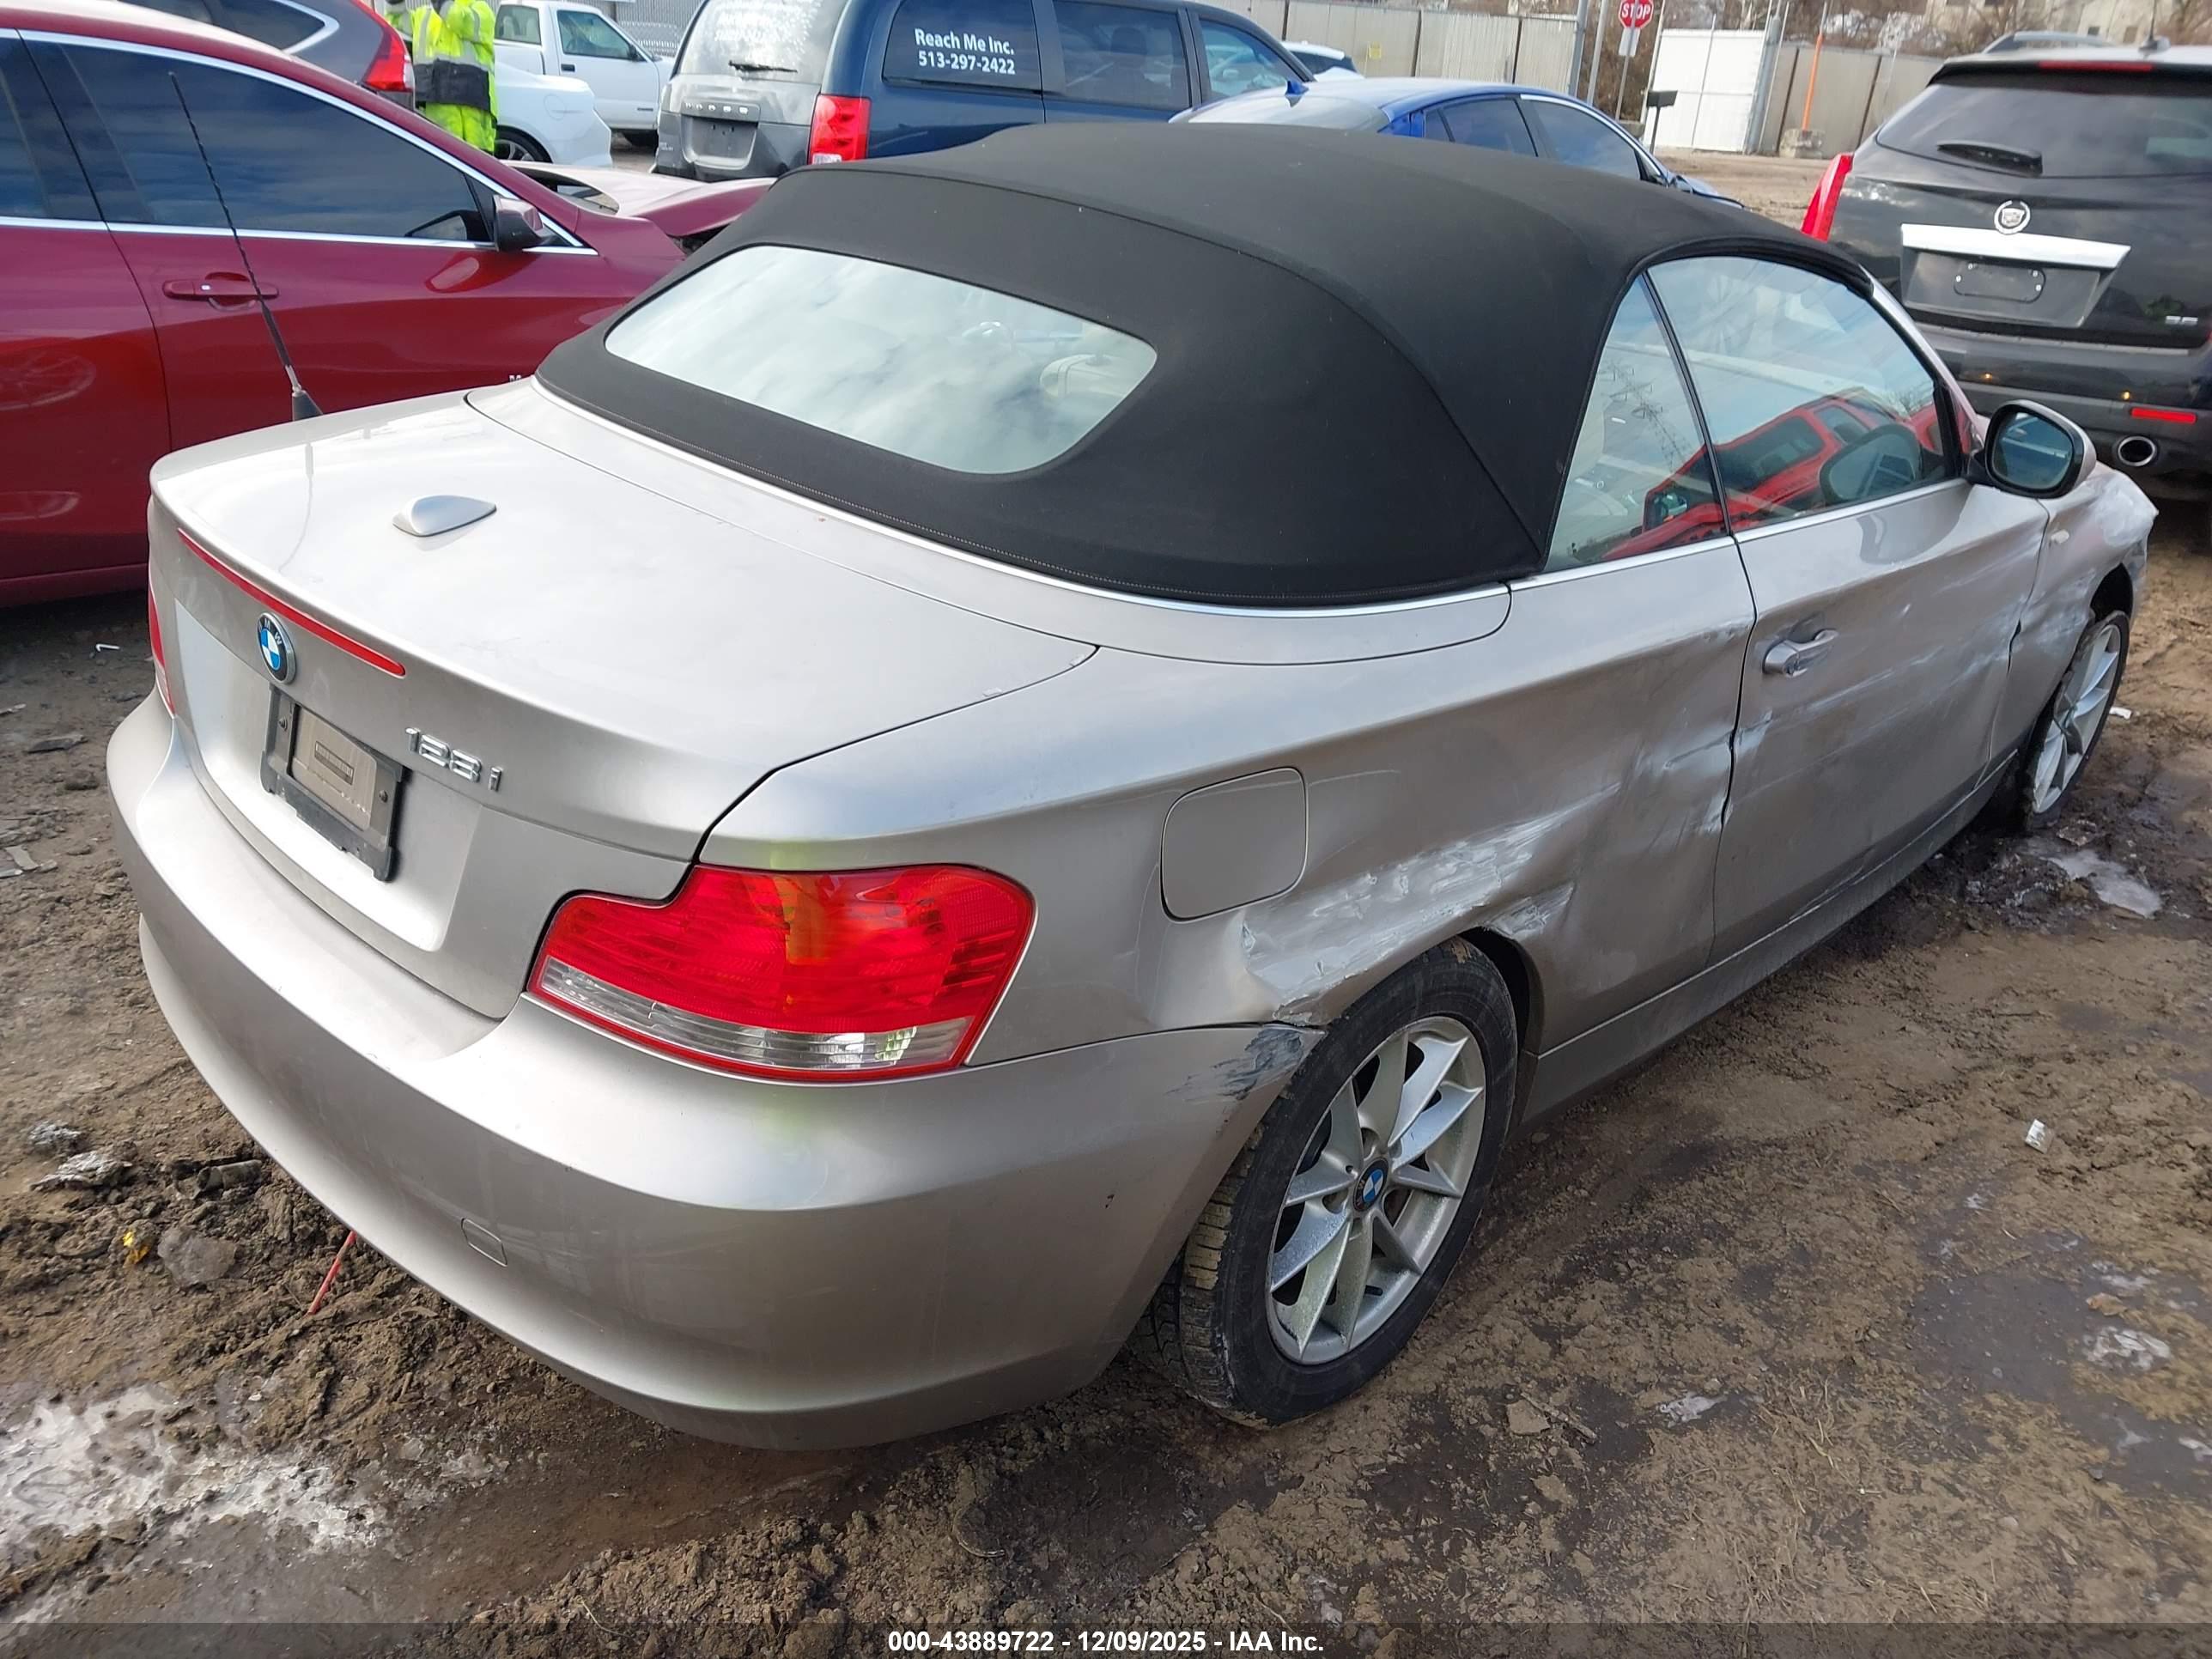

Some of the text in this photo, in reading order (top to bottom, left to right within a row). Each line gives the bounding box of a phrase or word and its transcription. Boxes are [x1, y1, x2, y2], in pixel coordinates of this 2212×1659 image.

[1621, 3, 1651, 20] STOP
[914, 27, 1015, 55] Reach Me Inc.
[918, 49, 1016, 75] 513-297-2422
[405, 726, 503, 792] 128i
